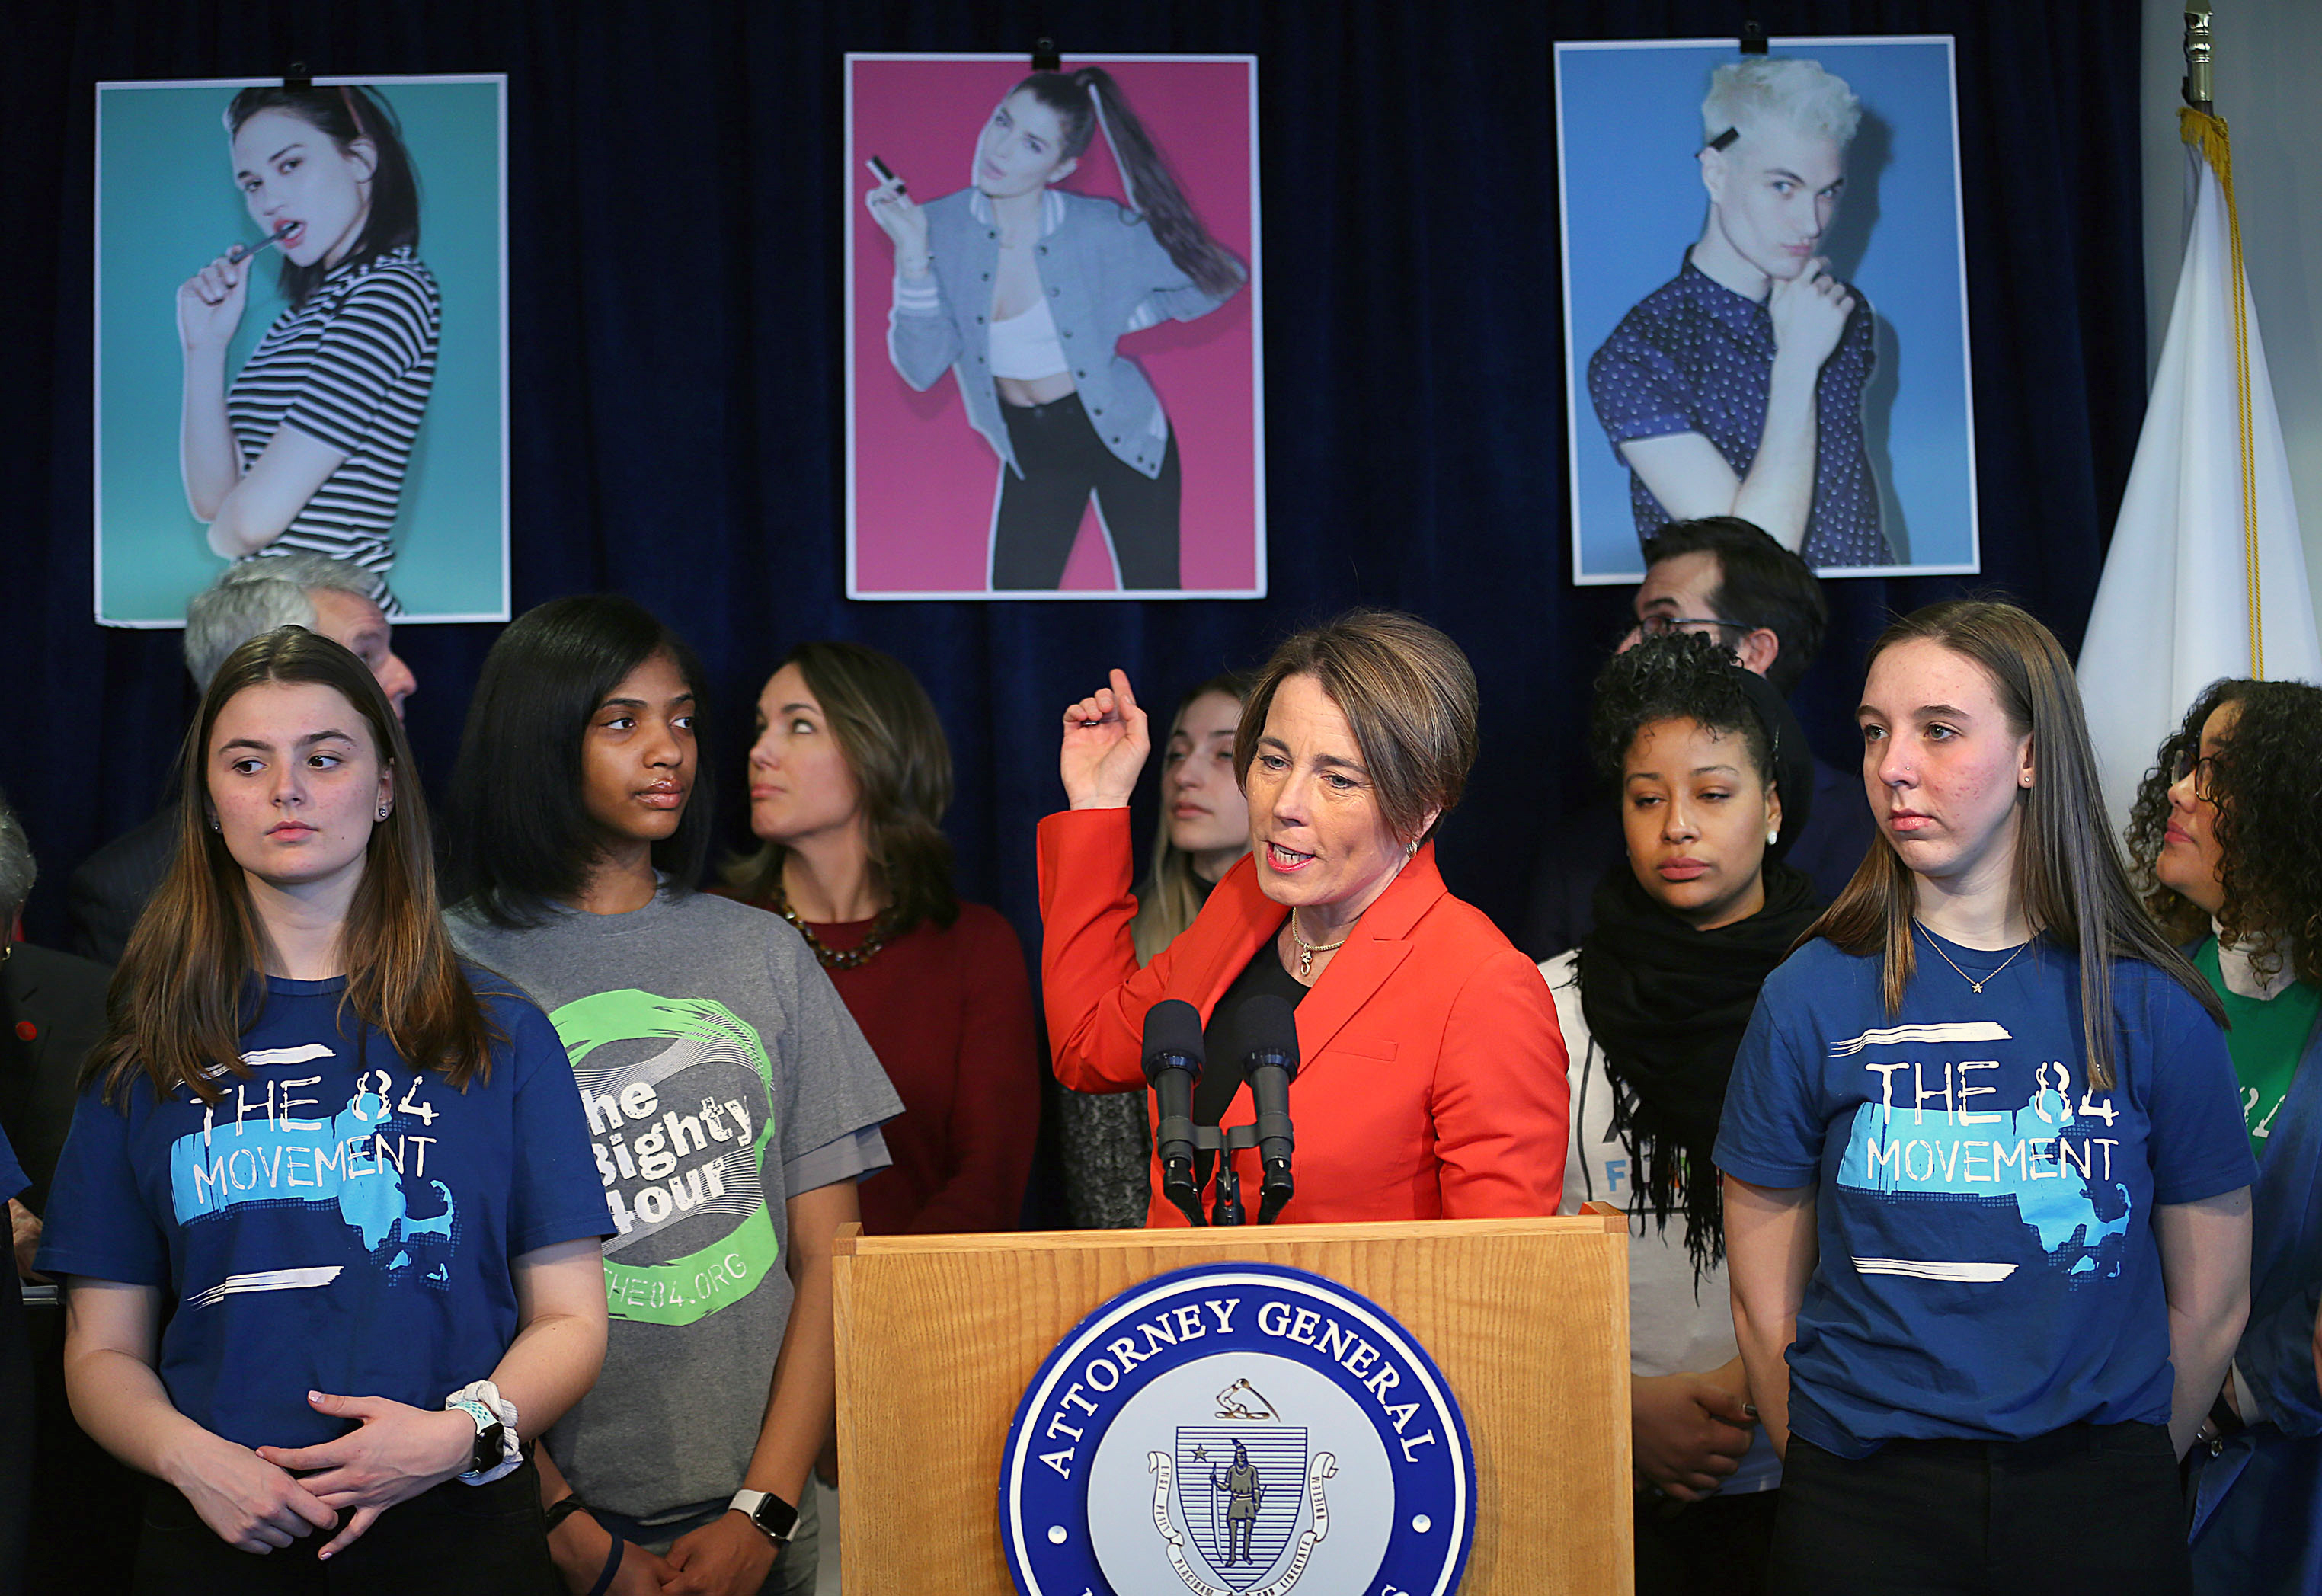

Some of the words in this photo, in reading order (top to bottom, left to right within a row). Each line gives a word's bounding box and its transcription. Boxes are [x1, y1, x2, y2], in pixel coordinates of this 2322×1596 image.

[189, 1075, 322, 1147] THE
[352, 1069, 440, 1126] 84
[580, 1082, 659, 1137] he
[1865, 1060, 2002, 1127] THE
[2036, 1060, 2120, 1127] 84
[192, 1133, 437, 1204] MOVEMENT
[1866, 1137, 2119, 1182] MOVEMENT
[1038, 1298, 1241, 1481] ATTORNEY
[1257, 1300, 1438, 1464] GENERAL
[1280, 1540, 1311, 1588] LIBERTATE
